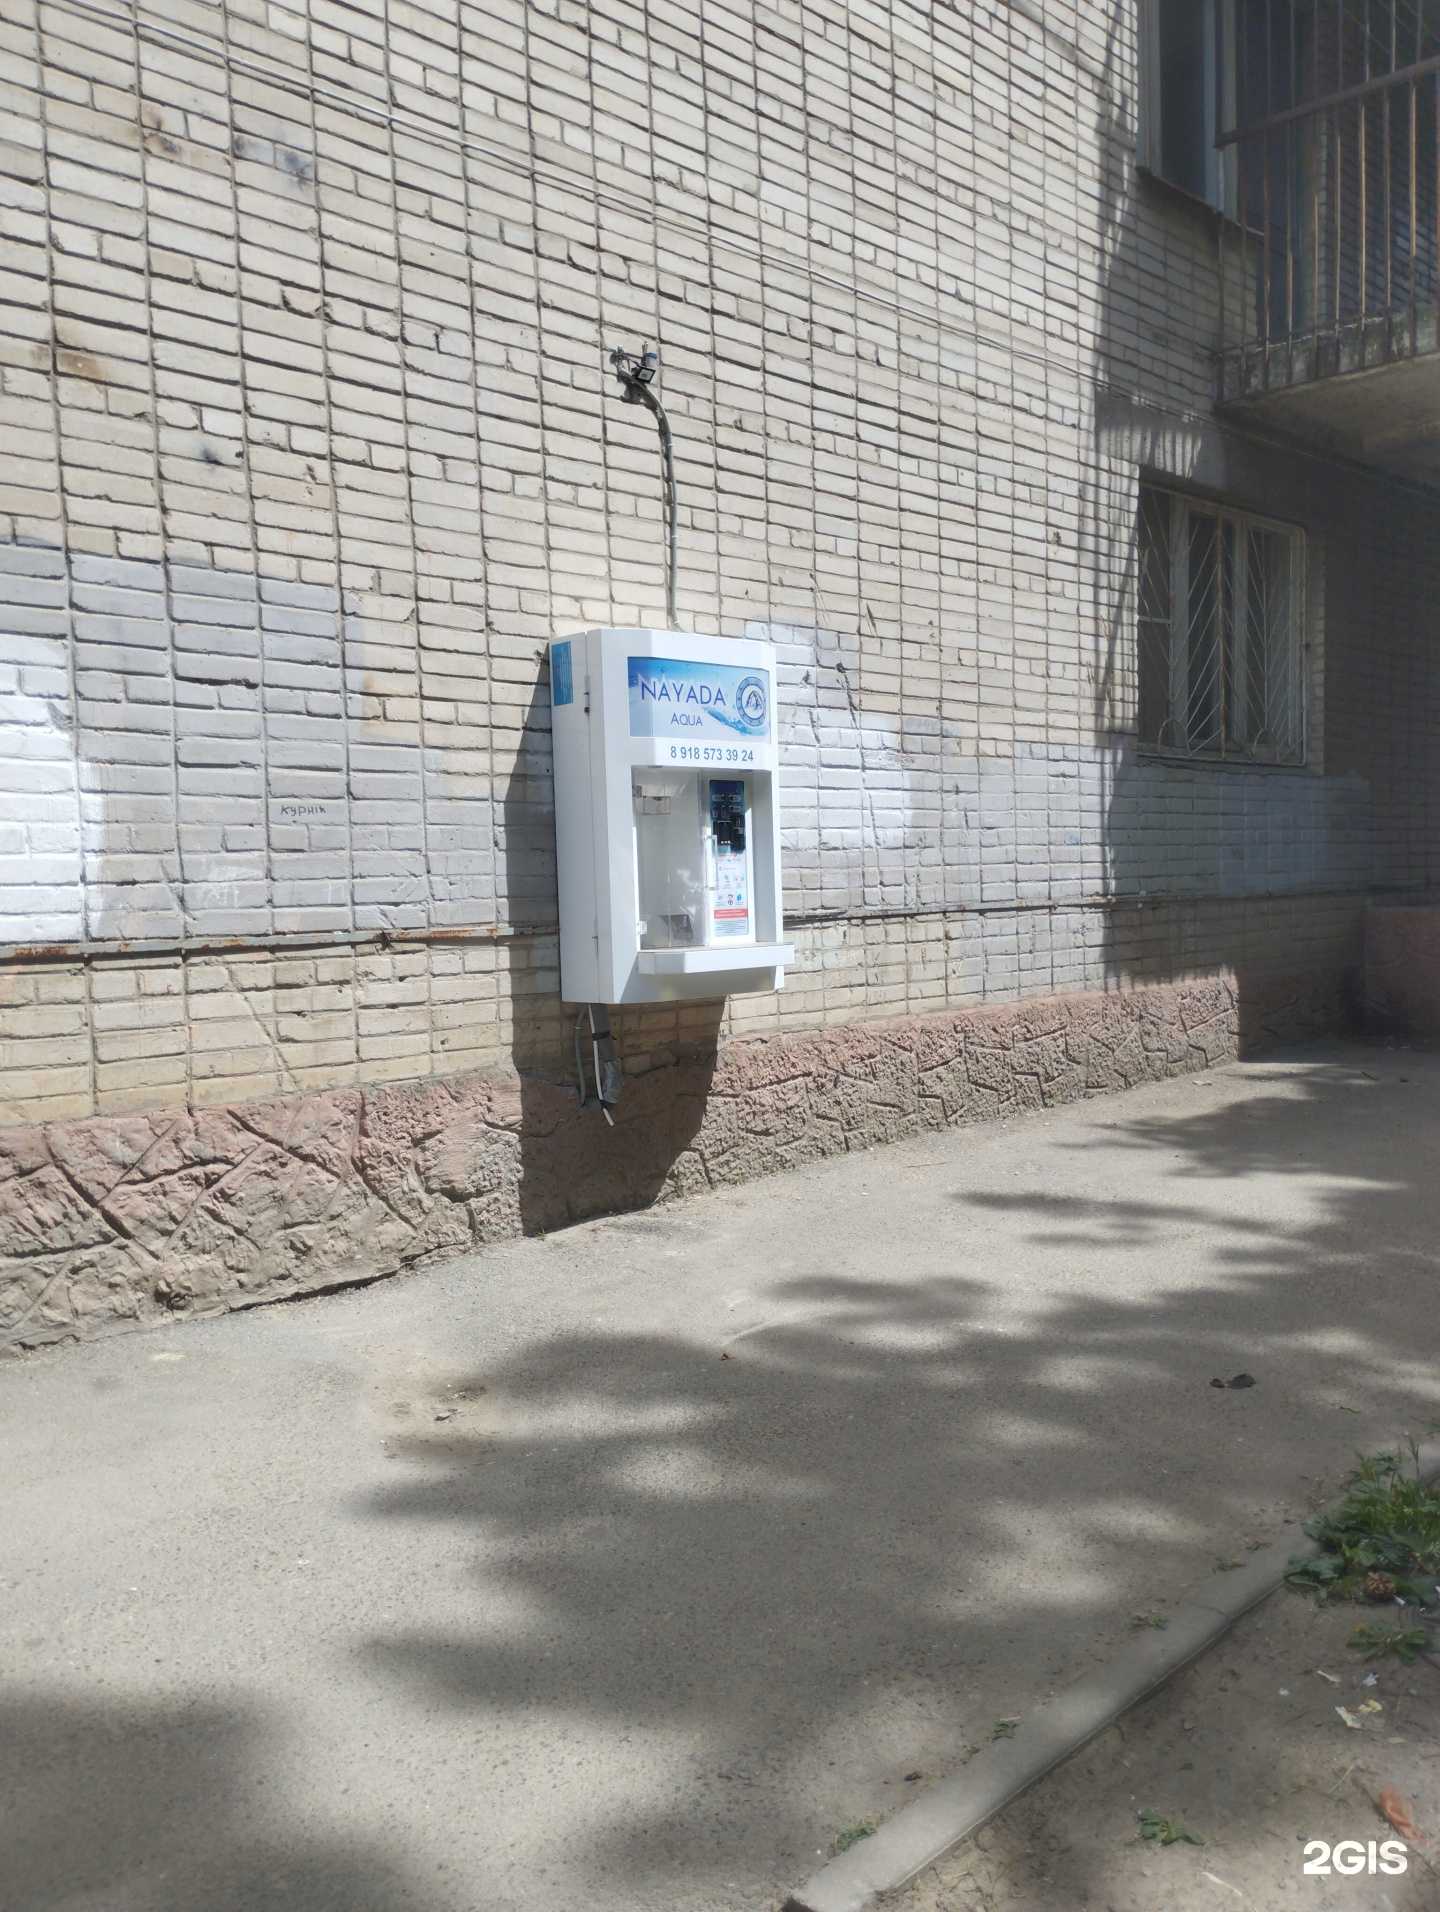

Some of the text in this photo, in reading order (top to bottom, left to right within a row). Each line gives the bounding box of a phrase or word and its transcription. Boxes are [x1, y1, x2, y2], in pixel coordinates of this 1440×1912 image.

[641, 681, 727, 705] NAYADA
[671, 713, 703, 726] AQUA
[671, 746, 754, 762] 8 918 573 39 24
